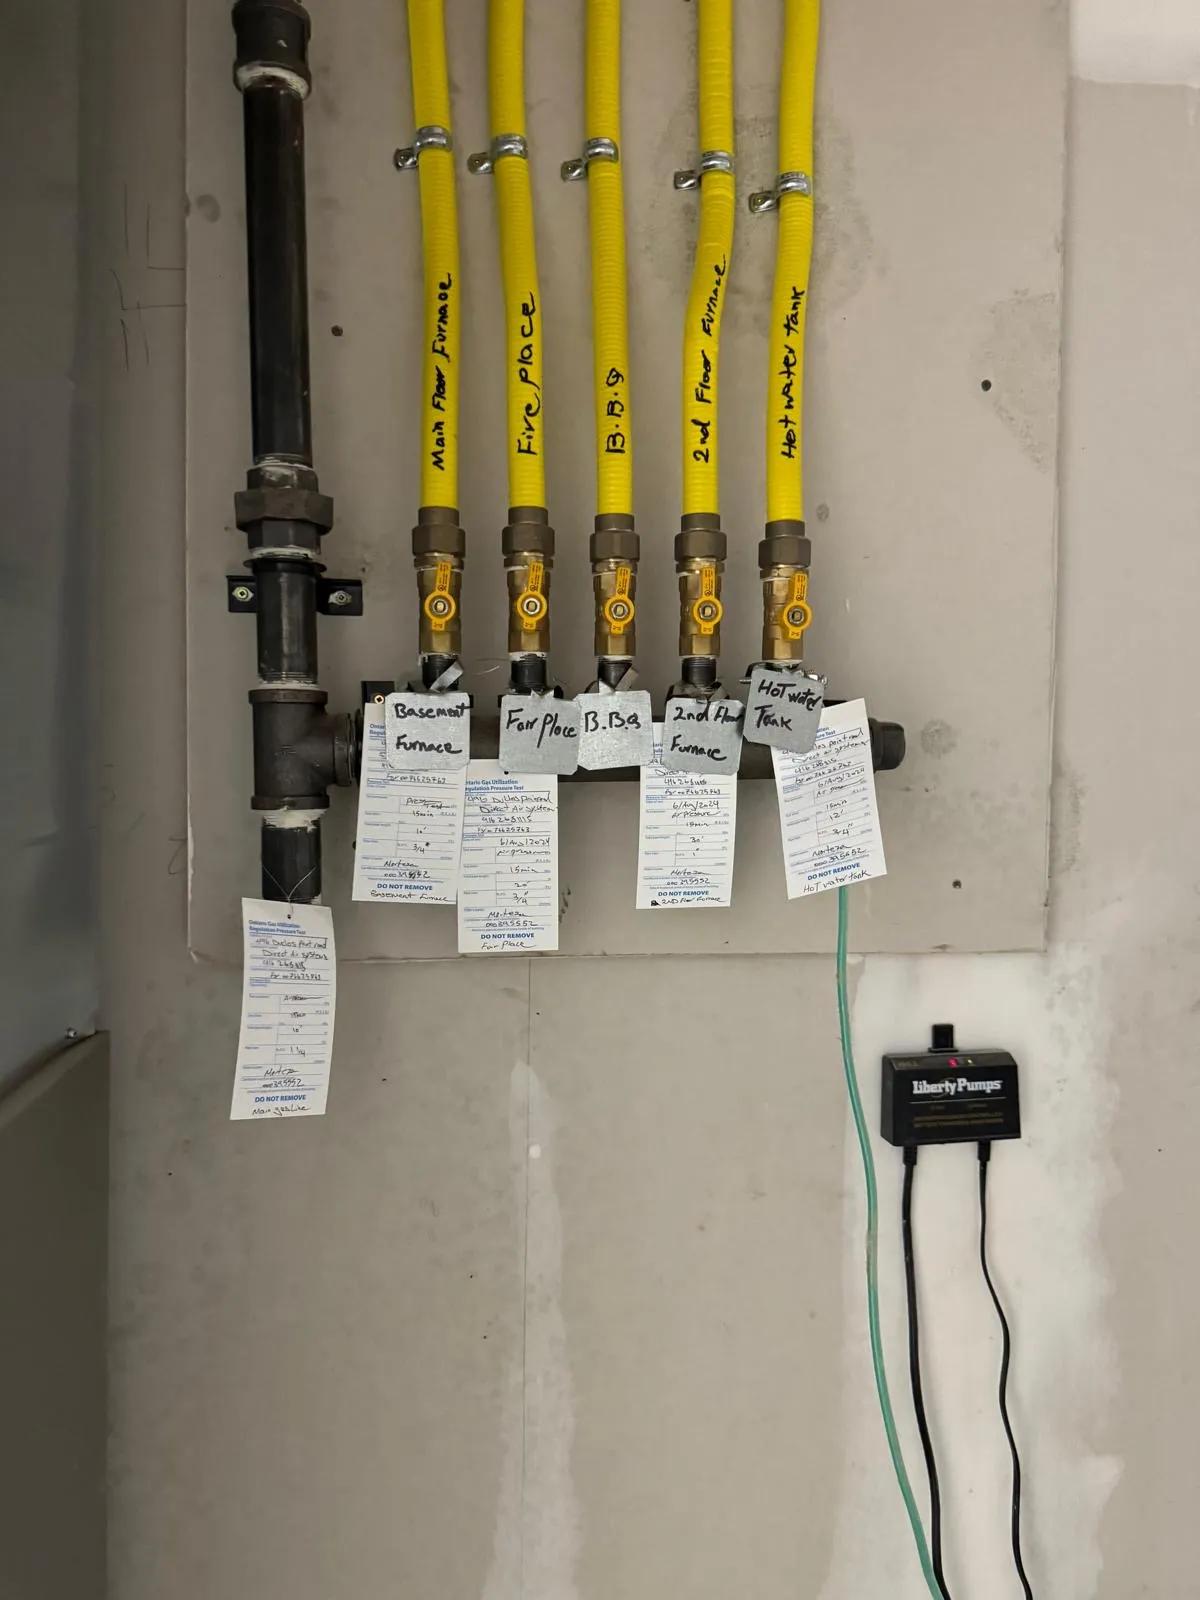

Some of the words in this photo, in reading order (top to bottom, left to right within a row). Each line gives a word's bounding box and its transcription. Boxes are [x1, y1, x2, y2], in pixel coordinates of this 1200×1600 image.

[702, 254, 726, 337] Furnace
[783, 286, 805, 337] tank
[432, 365, 446, 412] Floor
[695, 349, 712, 404] Floor
[778, 344, 797, 409] water
[517, 392, 540, 456] Fire
[605, 367, 626, 454] B.B.Q
[431, 420, 445, 471] Main
[691, 418, 711, 463] 2nd
[778, 414, 797, 459] Hot
[673, 706, 709, 722] 2nd
[755, 704, 793, 732] Tank
[395, 733, 463, 754] Furnace
[671, 734, 727, 760] Furnace
[807, 873, 818, 881] DO
[818, 870, 832, 878] NOT
[832, 862, 861, 874] REMOVE
[280, 1094, 307, 1102] REMOVE
[912, 1078, 957, 1096] Liberty
[956, 1077, 1001, 1094] Pumps
